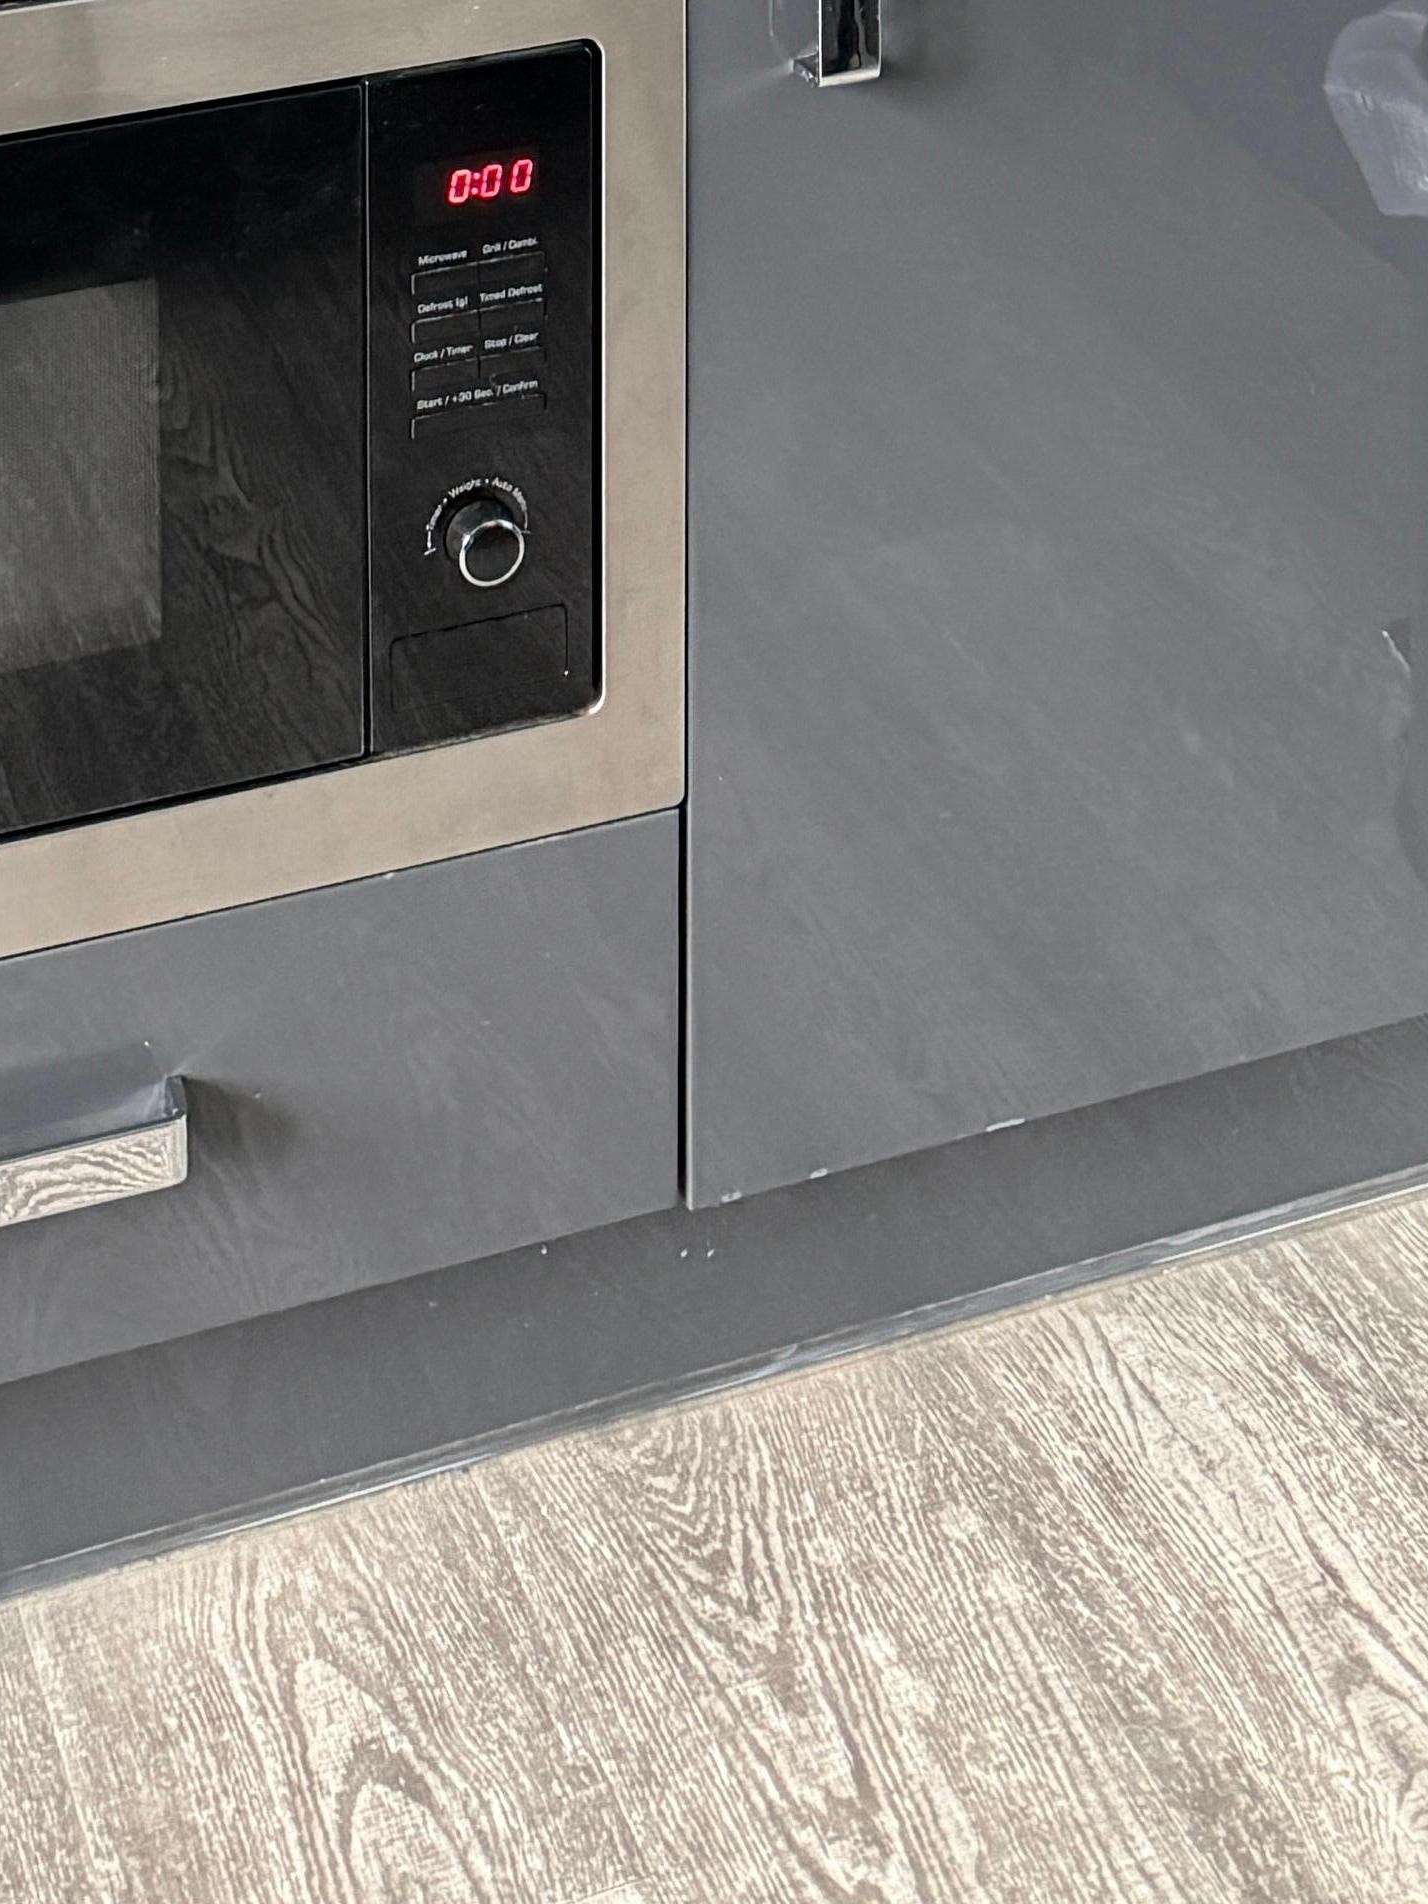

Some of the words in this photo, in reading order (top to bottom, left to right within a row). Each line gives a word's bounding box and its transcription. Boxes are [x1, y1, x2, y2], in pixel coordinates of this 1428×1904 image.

[449, 159, 533, 203] 0:00
[418, 250, 468, 266] Microwave
[479, 290, 506, 302] Timed
[508, 284, 543, 297] Defrost
[417, 300, 453, 314] Defrost
[514, 332, 540, 344] Clear
[414, 350, 438, 363] Clock
[446, 345, 474, 356] Timer
[416, 397, 443, 410] Start
[502, 380, 538, 394] Confirm
